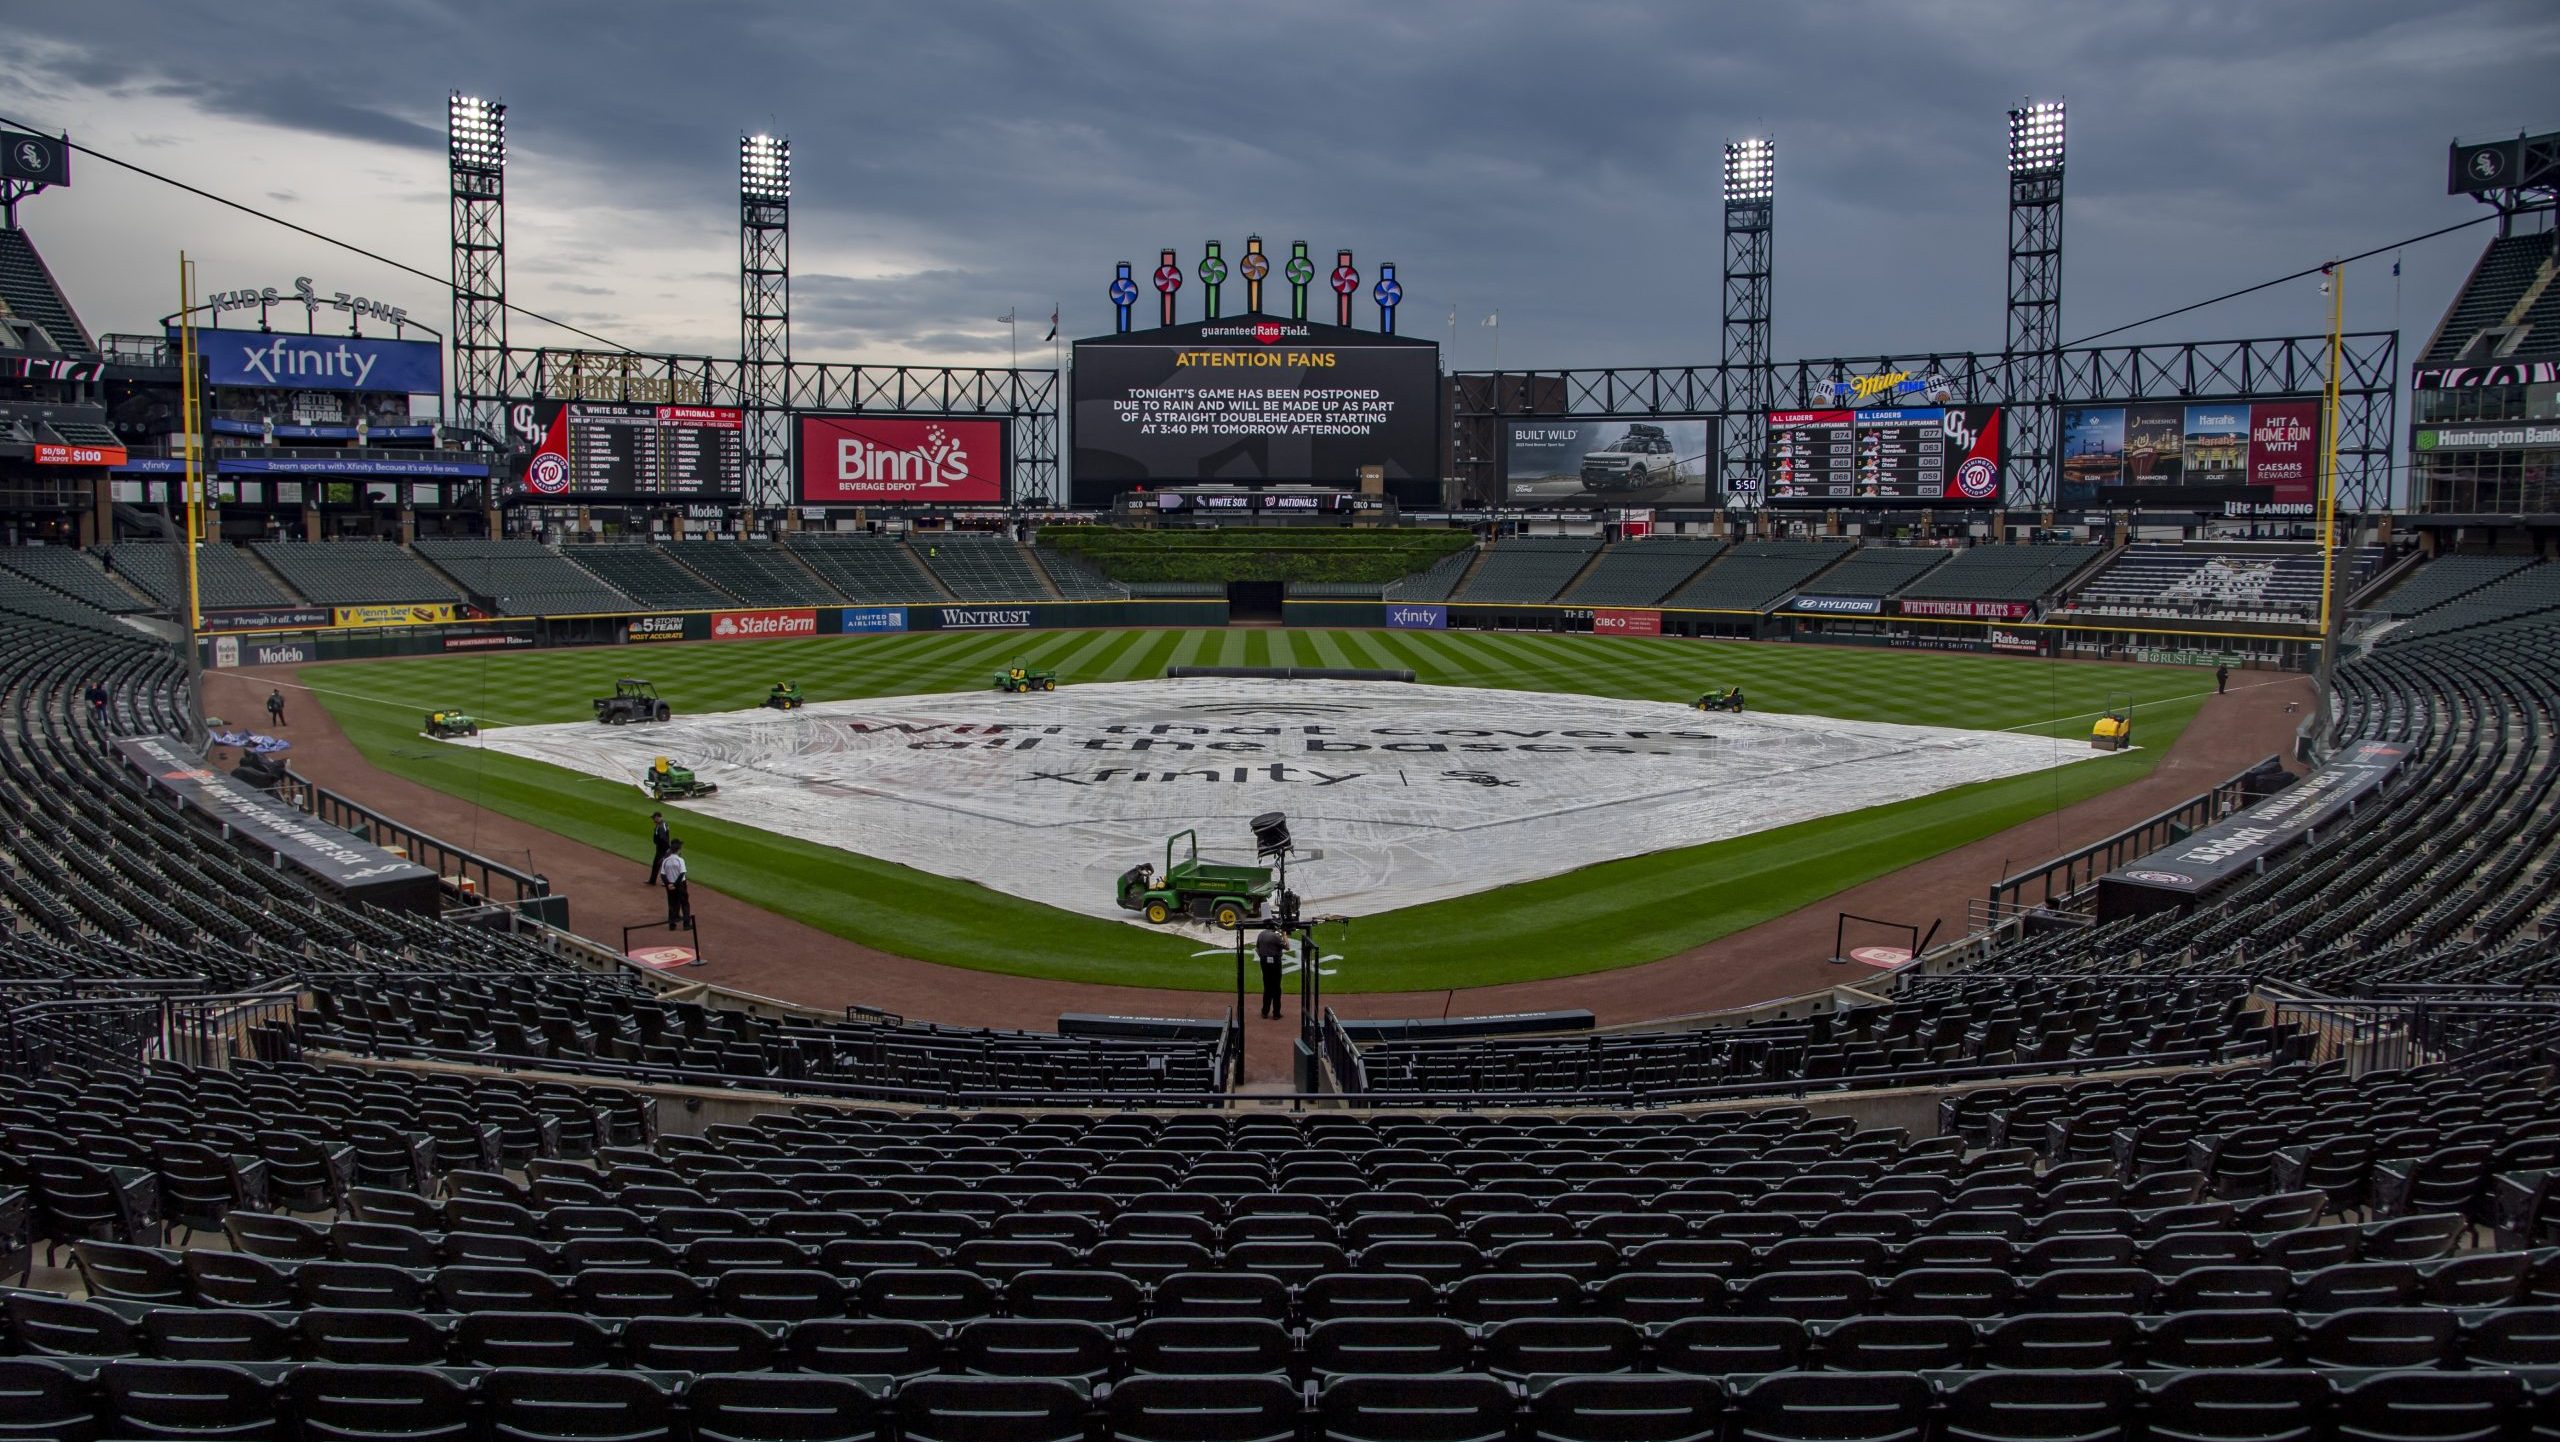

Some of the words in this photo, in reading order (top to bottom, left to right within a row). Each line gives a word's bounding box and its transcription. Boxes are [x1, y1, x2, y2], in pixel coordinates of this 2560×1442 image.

[210, 287, 279, 312] KIDS
[334, 292, 407, 327] ZONE
[1202, 326, 1256, 337] guaranteed
[1258, 327, 1279, 335] Rate
[243, 339, 377, 386] xfinity
[555, 354, 642, 371] CAESARS
[1176, 353, 1281, 367] ATTENTION
[1288, 353, 1336, 367] FANS
[554, 374, 702, 402] SPORTSBOOK
[1850, 371, 1911, 398] Miller
[1128, 389, 1194, 398] TONIGHT'S
[1199, 389, 1234, 398] GAME
[1238, 389, 1263, 398] HAS
[1267, 390, 1299, 399] BEEN
[1304, 390, 1379, 399] POSTPONED
[1114, 401, 1139, 410] DUE
[1141, 401, 1159, 410] TO
[1164, 401, 1193, 410] RAIN
[1198, 401, 1224, 410] AND
[1229, 401, 1259, 410] WILL
[1264, 402, 1279, 410] BE
[1283, 402, 1318, 411] MADE
[1323, 402, 1338, 411] UP
[1343, 402, 1358, 411] AS
[1363, 402, 1394, 411] PART
[1121, 413, 1138, 422] OF
[1142, 413, 1151, 422] A
[1155, 413, 1216, 422] STRAIGHT
[1220, 413, 1322, 422] DOUBLEHEADER
[1326, 414, 1386, 423] STARTING
[2266, 417, 2287, 427] HIT
[2290, 417, 2300, 426] A
[1141, 425, 1156, 434] AT
[1160, 425, 1187, 434] 3:40
[1191, 425, 1208, 434] PM
[1212, 425, 1288, 434] TOMORROW
[1292, 426, 1369, 434] AFTERNOON
[2254, 428, 2285, 441] HOME
[2287, 427, 2310, 441] RUN
[1516, 431, 1545, 440] BUILT
[1548, 431, 1576, 440] WILD
[2439, 431, 2524, 448] Huntington
[2266, 442, 2297, 451] WITH
[73, 451, 101, 462] $100
[534, 455, 567, 469] WASHINGTON
[300, 463, 325, 472] sports
[347, 463, 374, 472] Xfinity.
[408, 464, 417, 472] it's
[418, 465, 432, 473] only
[1962, 460, 1995, 474] WASHINGTON
[536, 479, 566, 490] NATIONALS
[1516, 485, 1533, 493] Ford
[1736, 480, 1756, 489] 5:50
[1962, 484, 1993, 495] NATIONALS
[1278, 498, 1317, 508] NATIONALS
[2224, 501, 2250, 516] Lite
[2255, 504, 2313, 514] LANDING
[689, 505, 723, 517] Modelo
[1819, 601, 1872, 610] HYUNDAI
[1904, 601, 1971, 615] WHITTINGHAM
[1975, 604, 2008, 616] MEATS
[356, 607, 387, 617] Vienna
[390, 607, 410, 616] Beef
[942, 608, 1030, 625] WINTRUST
[1394, 609, 1436, 625] xfinity
[233, 617, 268, 626] Through
[643, 618, 653, 632] 5
[1596, 618, 1616, 626] CIBC
[1992, 631, 2037, 645] Rate.com
[260, 648, 303, 663] Modelo
[2161, 654, 2191, 664] RUSH
[1371, 728, 1718, 739] covers
[1073, 738, 1266, 751] the
[1306, 739, 1672, 754] bases.
[1016, 762, 1367, 786] xfinity
[290, 831, 343, 852] WHITE
[326, 849, 372, 865] SOX
